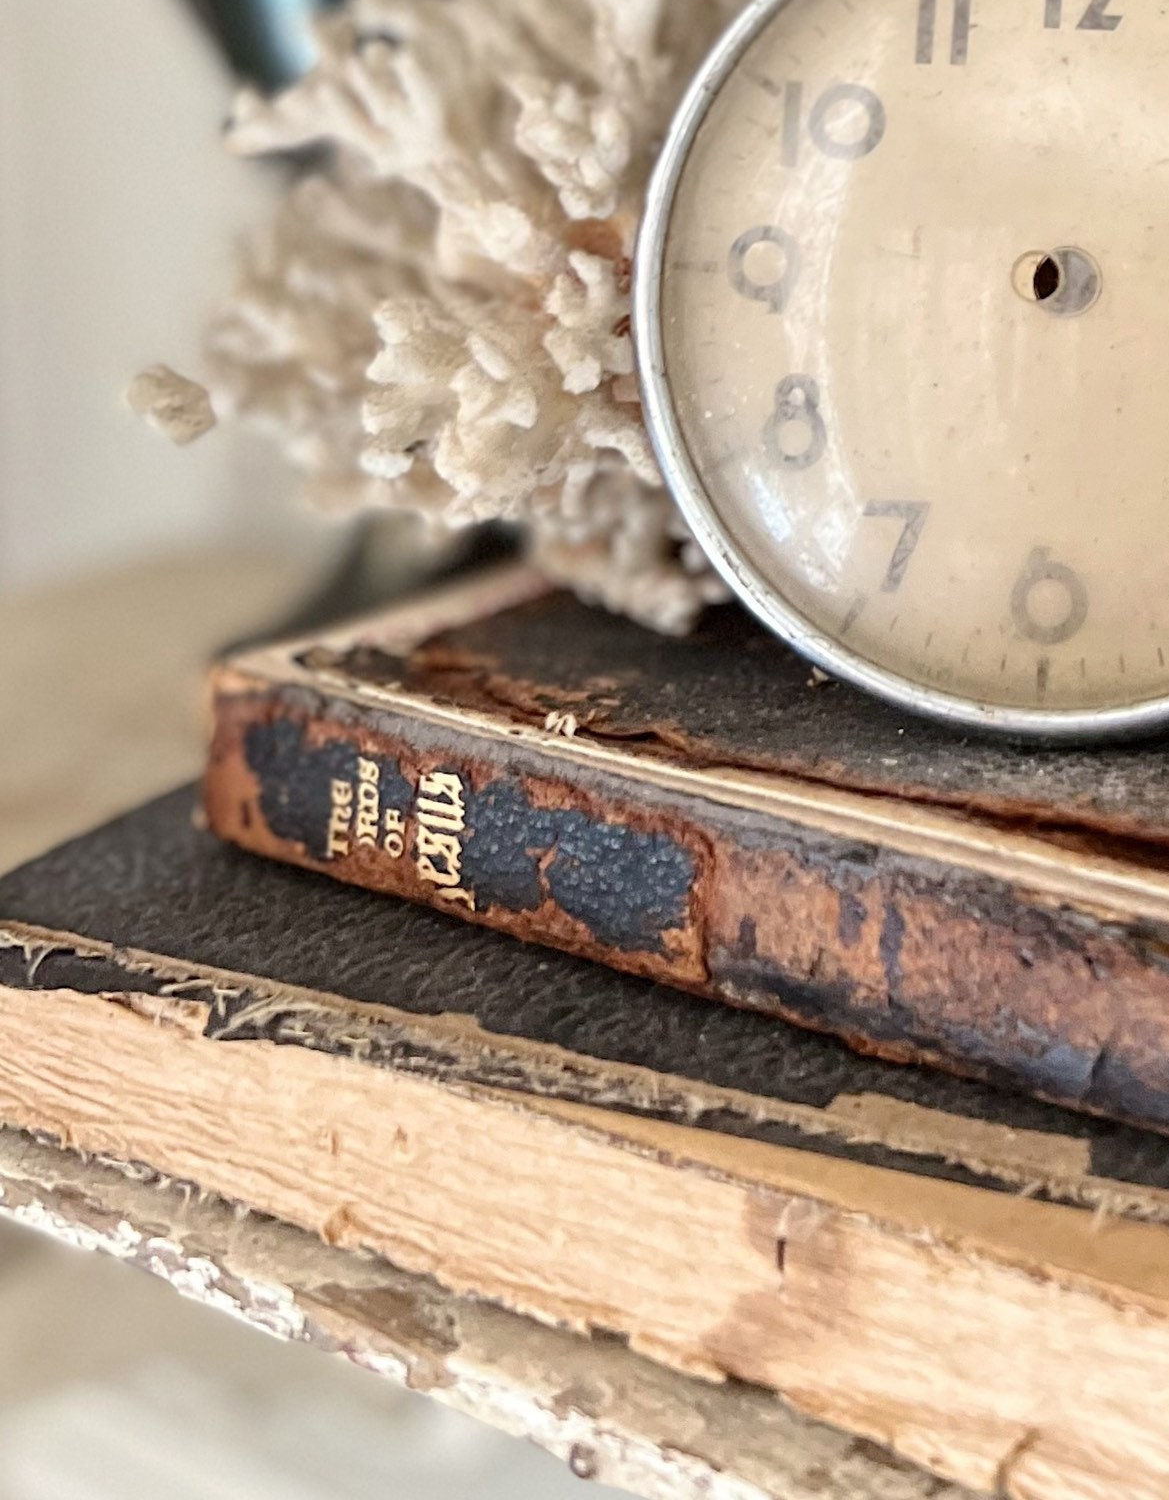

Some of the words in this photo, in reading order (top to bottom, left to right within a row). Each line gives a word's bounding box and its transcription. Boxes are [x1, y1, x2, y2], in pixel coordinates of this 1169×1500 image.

[779, 81, 887, 168] 10
[727, 225, 800, 315] 9
[762, 373, 828, 471] 8
[862, 501, 931, 593] 7
[1009, 545, 1090, 645] 6
[384, 808, 406, 858] OF
